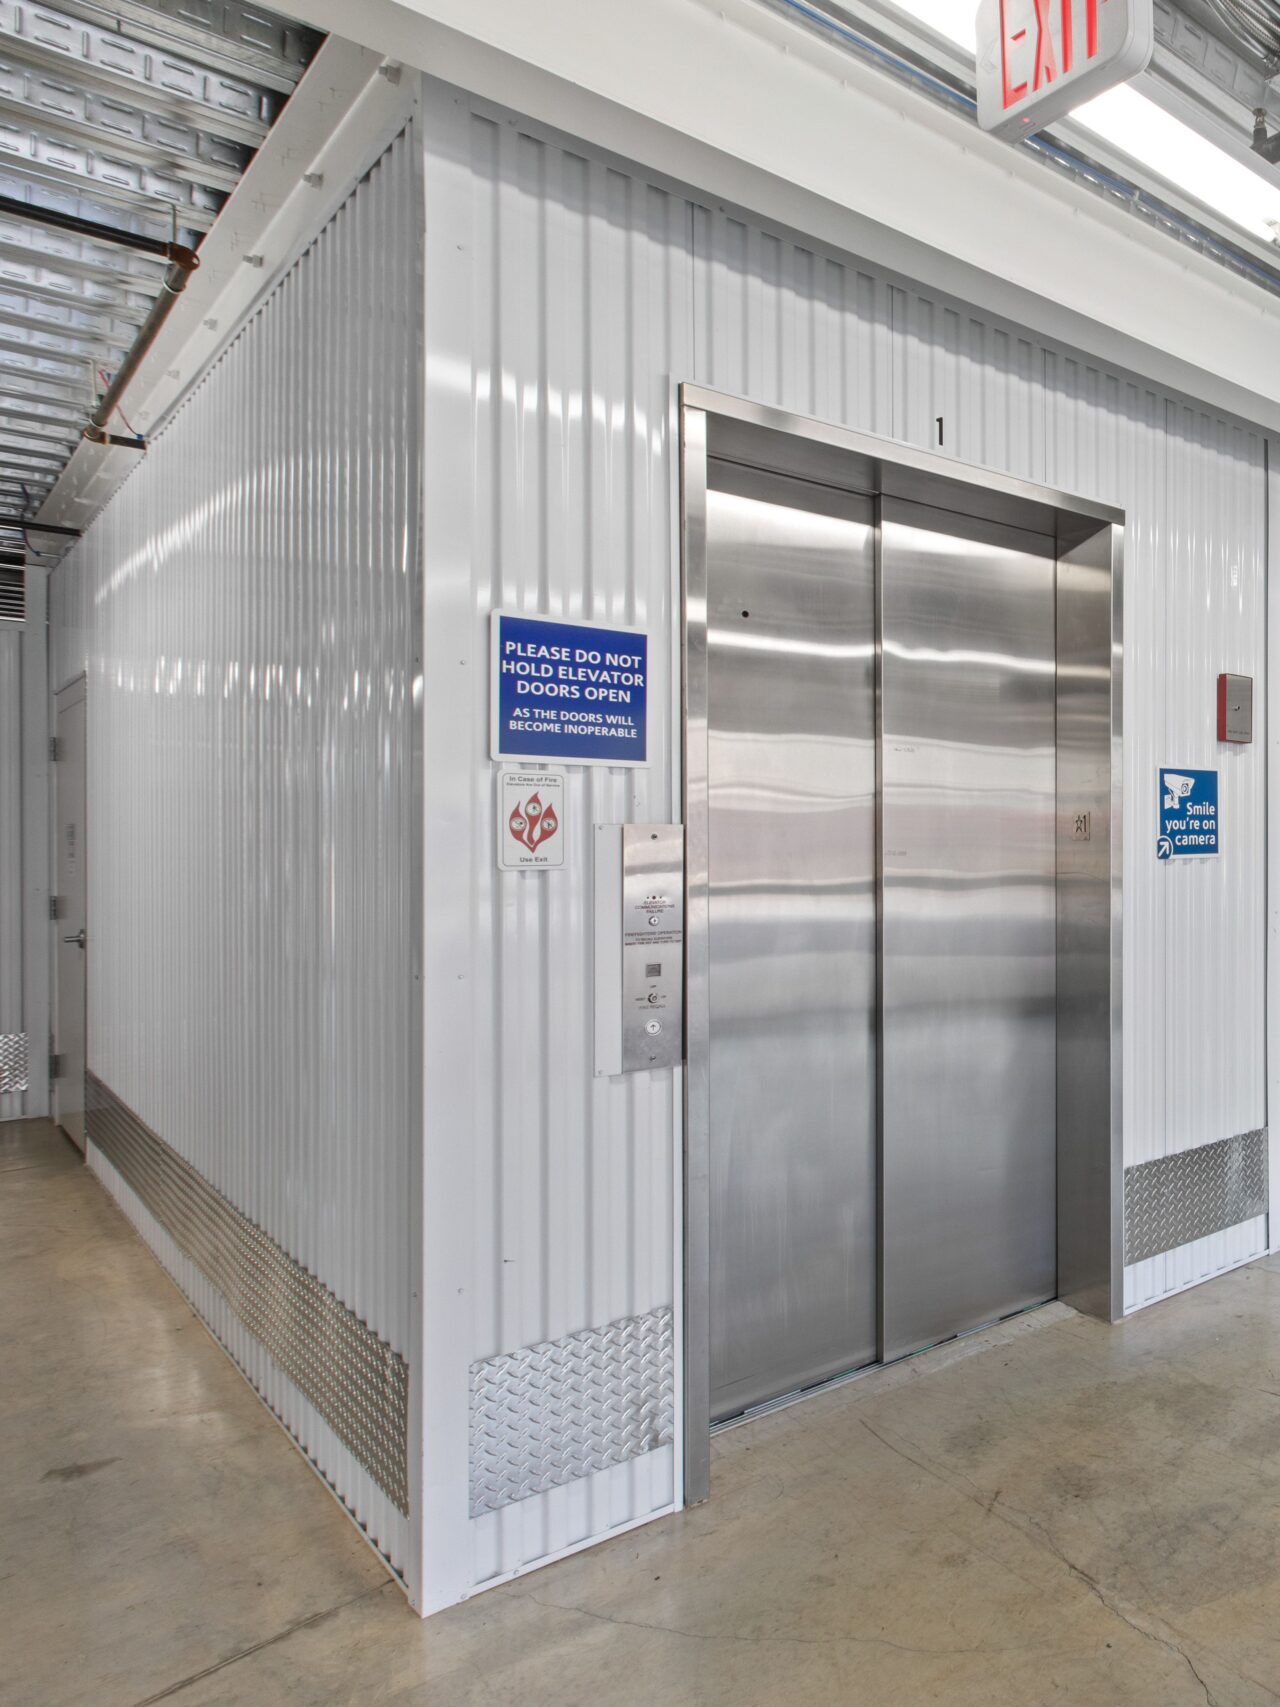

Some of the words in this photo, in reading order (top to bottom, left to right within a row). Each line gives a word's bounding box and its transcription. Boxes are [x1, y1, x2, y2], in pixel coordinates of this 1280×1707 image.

[935, 416, 944, 446] 1
[505, 641, 571, 661] PLEASE
[575, 649, 601, 664] DO
[605, 653, 642, 669] NOT
[502, 660, 553, 678] HOLD
[558, 666, 644, 687] ELEVATOR
[517, 680, 580, 699] DOORS
[584, 687, 631, 703] OPEN
[513, 708, 530, 718] AS
[533, 709, 557, 720] THE
[560, 711, 603, 723] DOORS
[605, 715, 634, 726] WILL
[509, 720, 562, 733] BECOME
[564, 724, 637, 738] INOPERABLE
[1186, 802, 1216, 815] Smile
[1165, 816, 1200, 834] you're
[1202, 820, 1216, 830] on
[1175, 834, 1216, 846] camera
